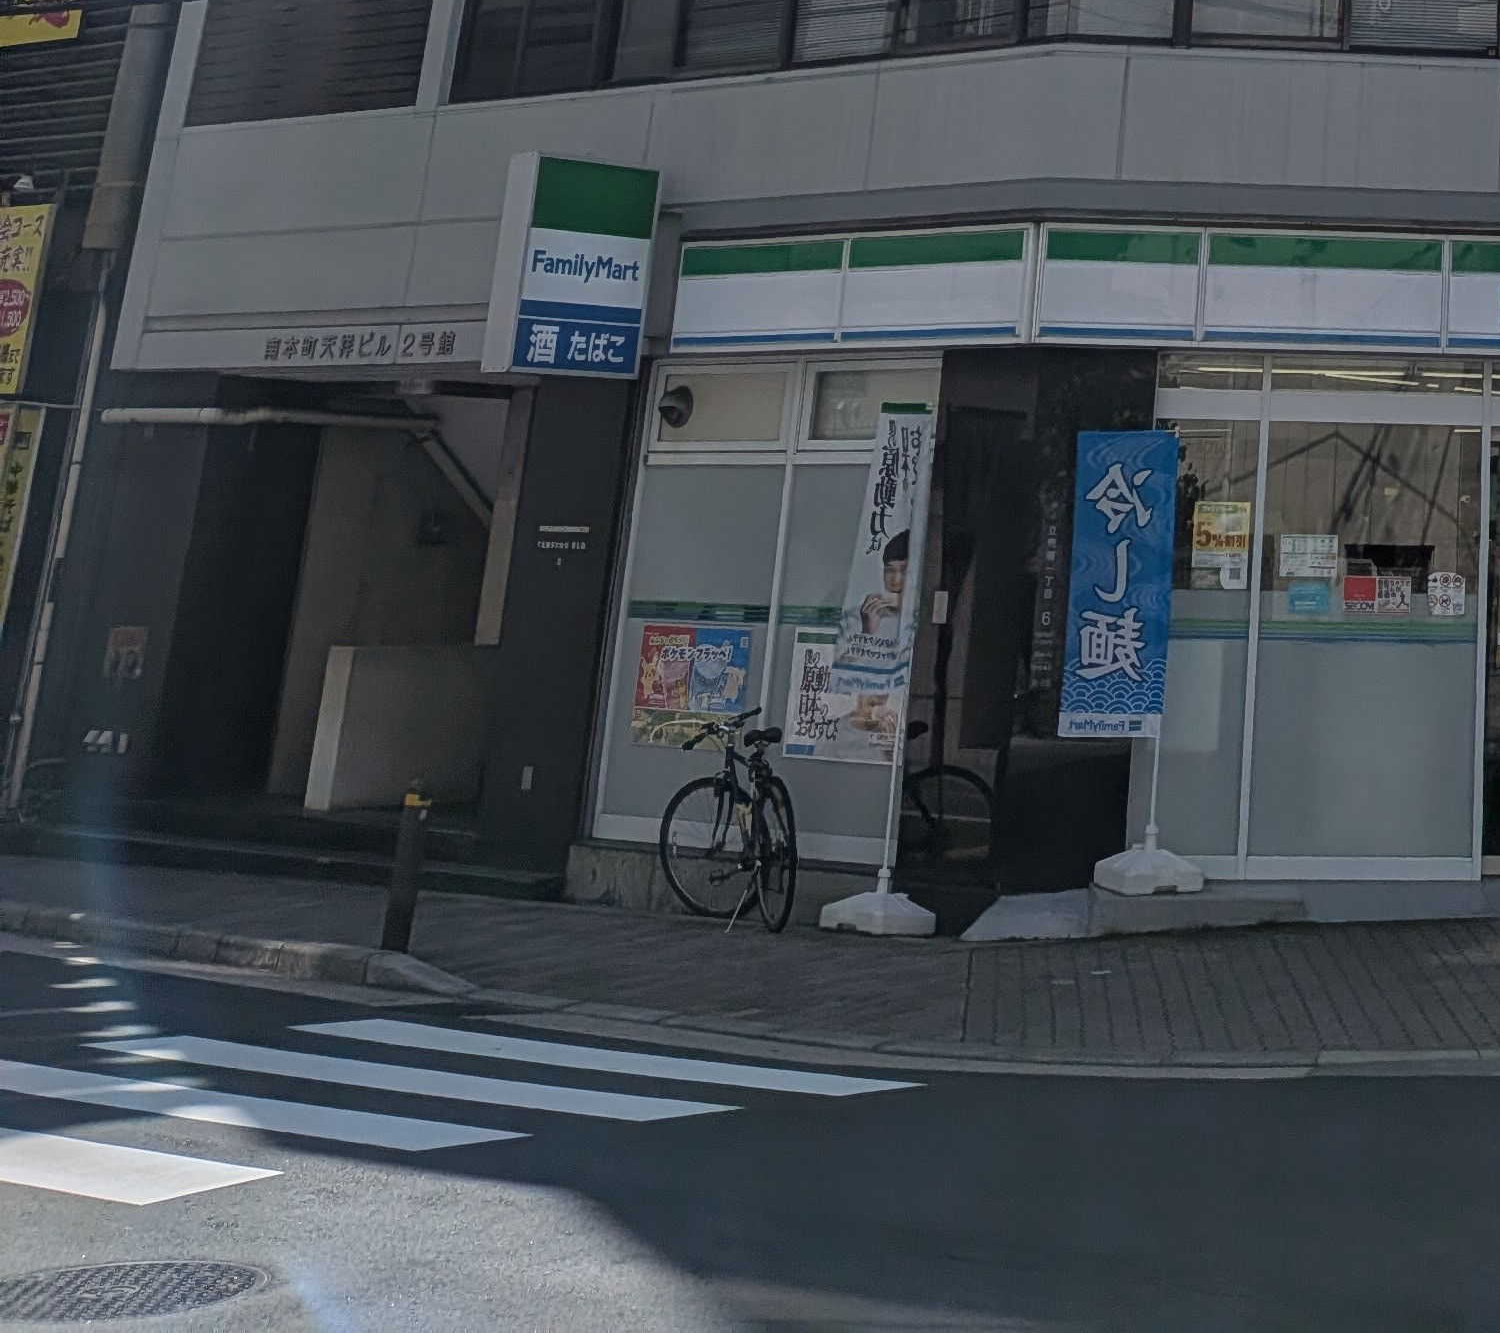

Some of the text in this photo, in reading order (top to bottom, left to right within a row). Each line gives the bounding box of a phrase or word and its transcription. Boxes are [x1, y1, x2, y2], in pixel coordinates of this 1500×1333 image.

[531, 249, 640, 283] FamilyMart
[526, 323, 626, 364] 酒 たばこ
